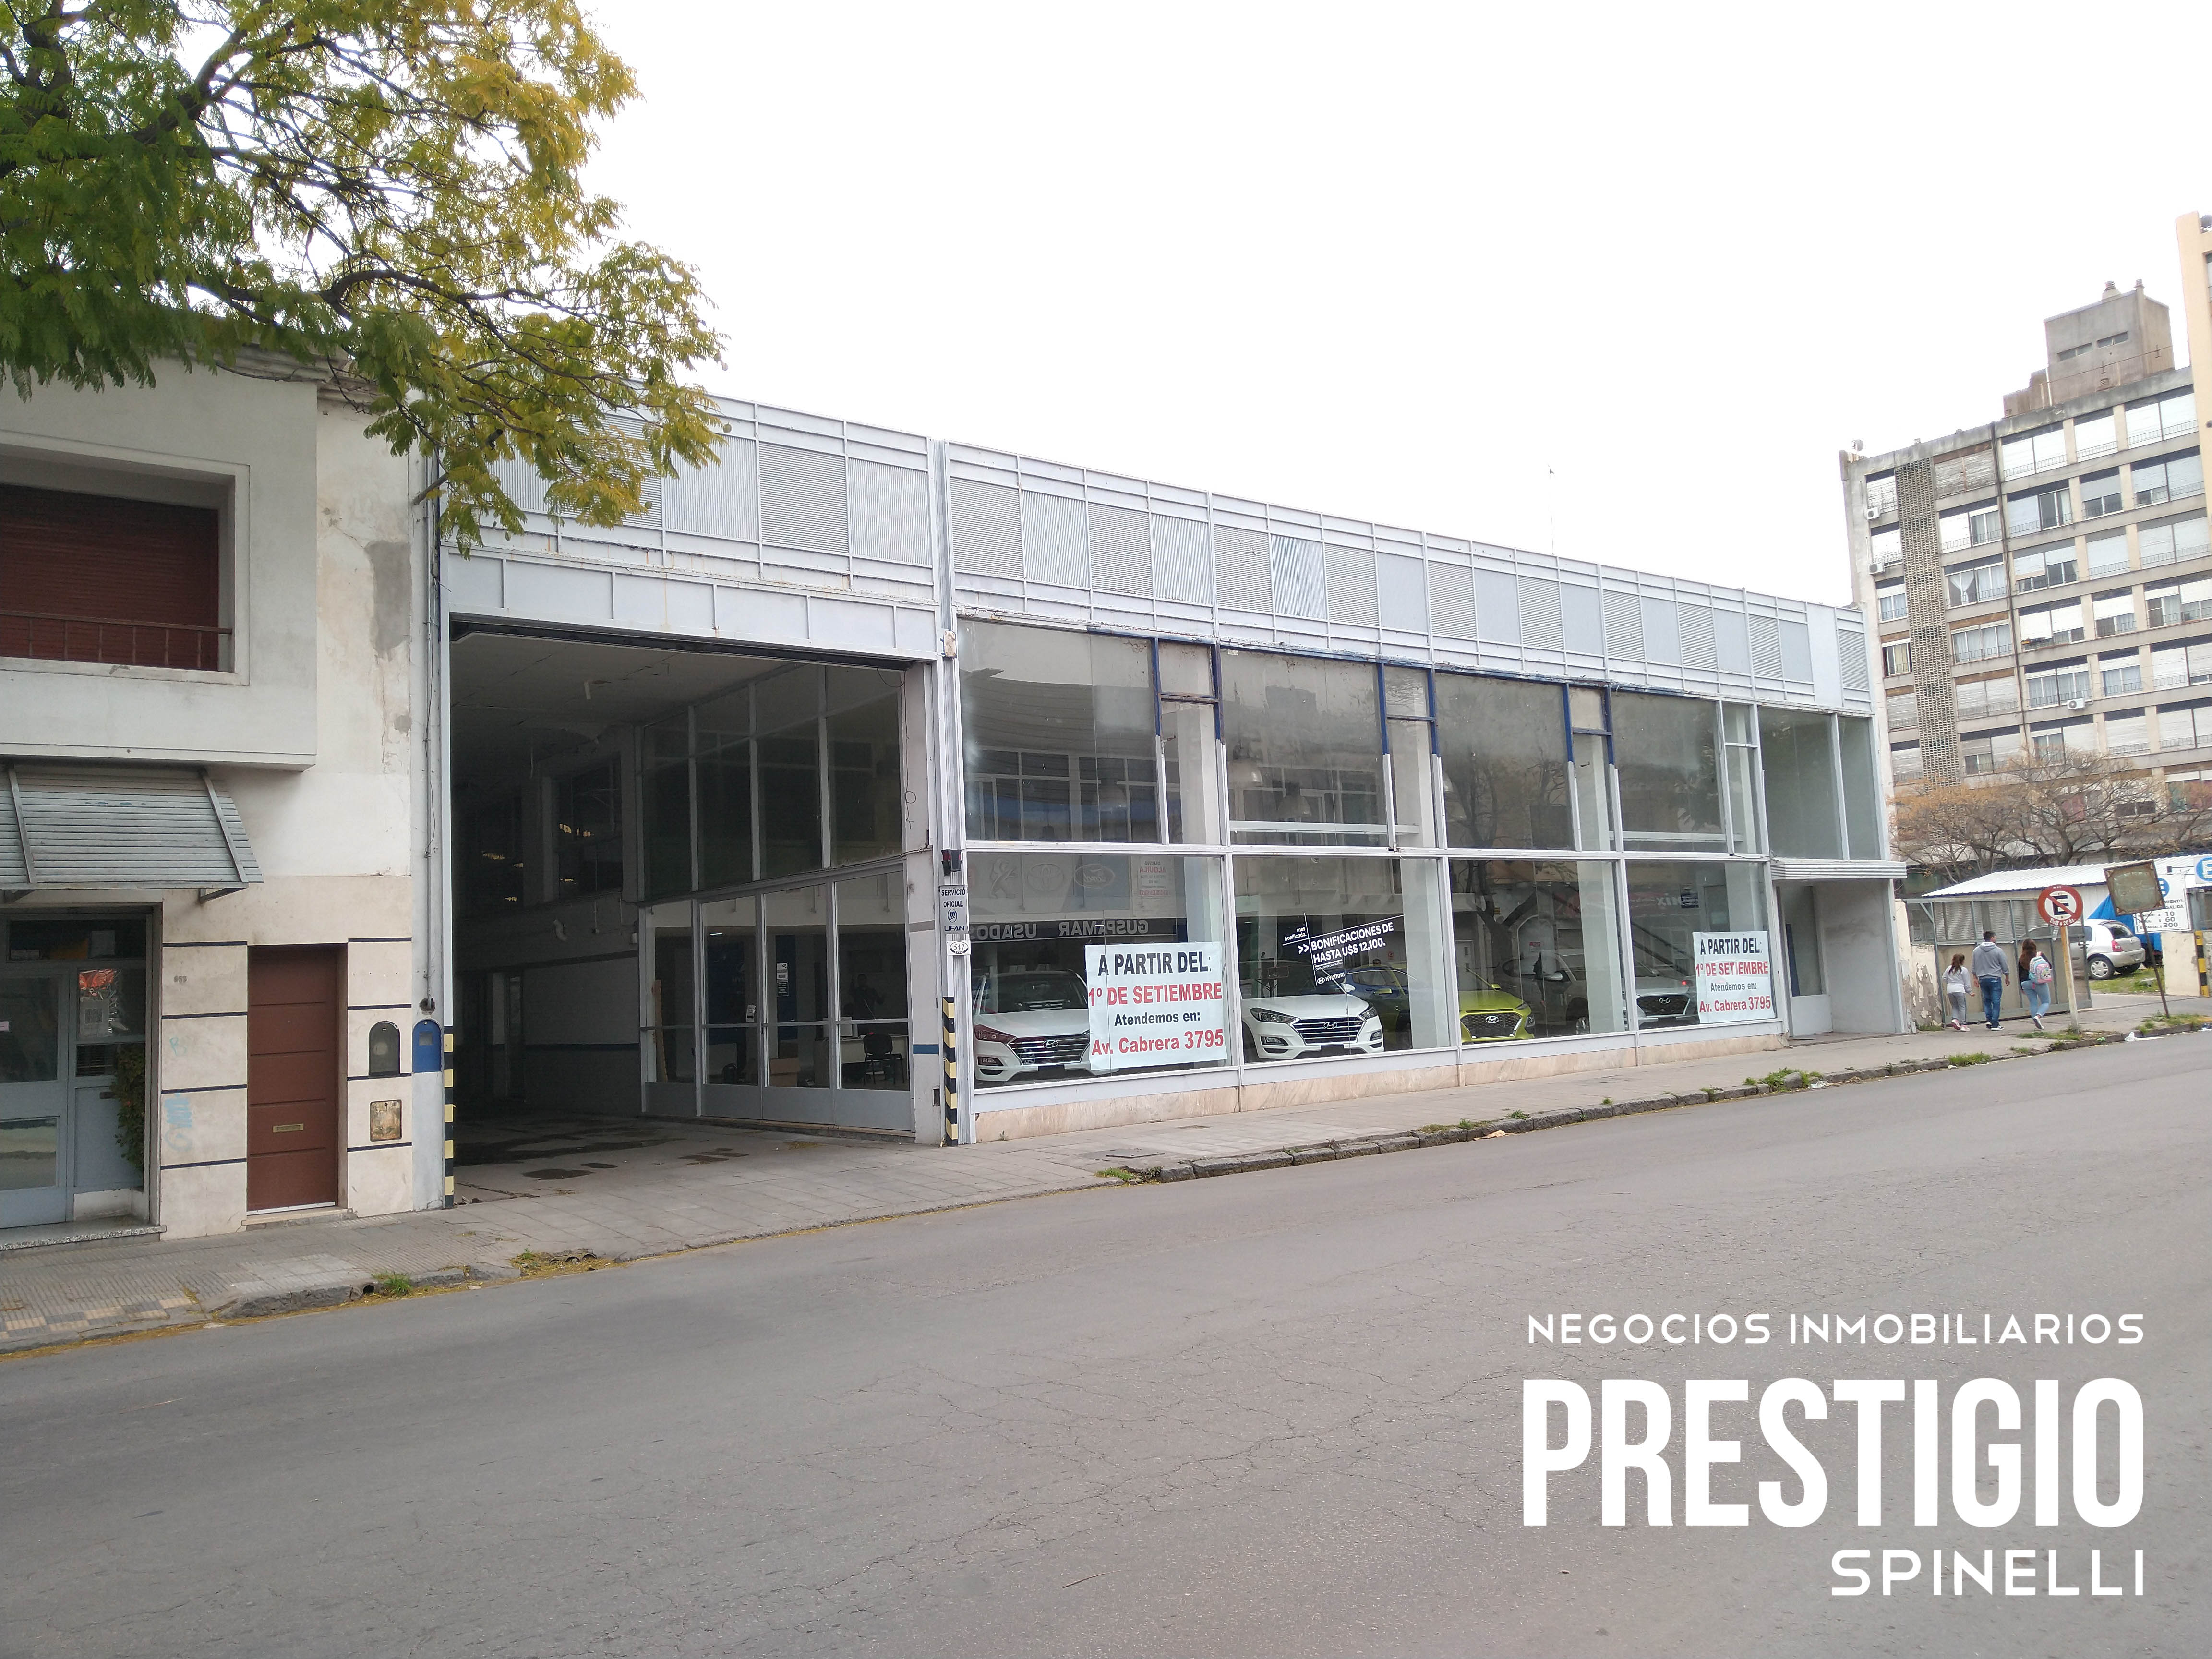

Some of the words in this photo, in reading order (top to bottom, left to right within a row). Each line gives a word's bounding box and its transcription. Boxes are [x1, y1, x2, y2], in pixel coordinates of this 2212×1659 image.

[1284, 932, 1307, 941] bonificado.
[1310, 926, 1382, 951] BONIFICACIONES
[1382, 922, 1394, 933] DE
[1313, 948, 1342, 964] HASTA
[1342, 943, 1358, 956] U$S
[1358, 938, 1386, 952] 12.100.
[1700, 939, 1706, 955] A
[1708, 938, 1740, 955] PARTIR
[1743, 938, 1762, 954] DEL:
[1098, 954, 1109, 976] A
[1114, 952, 1173, 975] PARTIR
[1178, 951, 1212, 973] DEL:
[1706, 962, 1717, 977] DE
[1719, 961, 1768, 976] SETIEMBRE
[1325, 972, 1345, 982] HYUNDAI
[1107, 986, 1128, 1006] DE
[1133, 982, 1223, 1004] SETIEMBRE
[1710, 982, 1746, 992] Atendemos
[1699, 1000, 1712, 1013] Av.
[1714, 999, 1747, 1012] Cabrera
[1748, 995, 1771, 1010] 3795
[1114, 1012, 1179, 1026] Atendemos
[1183, 1011, 1201, 1022] en:
[1091, 1039, 1114, 1056] Av.
[1118, 1036, 1180, 1054] Cabrera
[1184, 1029, 1224, 1050] 3795
